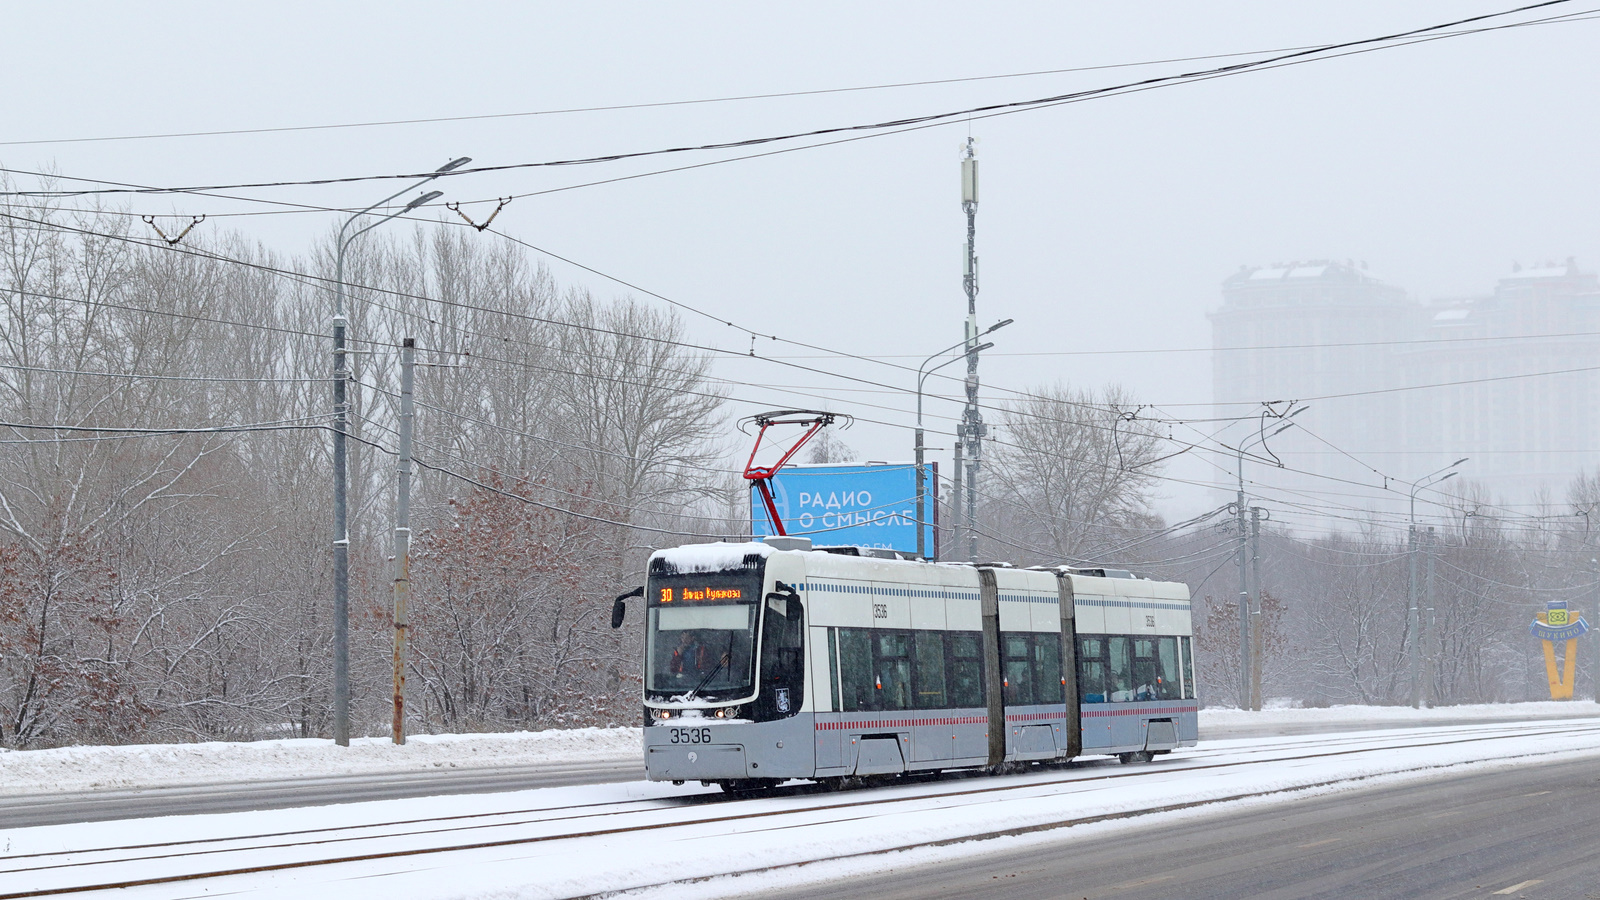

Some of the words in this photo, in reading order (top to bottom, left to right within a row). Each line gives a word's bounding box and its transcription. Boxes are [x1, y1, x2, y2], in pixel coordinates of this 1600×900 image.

[800, 490, 872, 509] РАДИО
[800, 512, 814, 528] О
[822, 510, 913, 528] СМЫСЛЕ
[660, 588, 673, 602] 30
[874, 603, 888, 619] 3536
[670, 728, 711, 743] 3536
